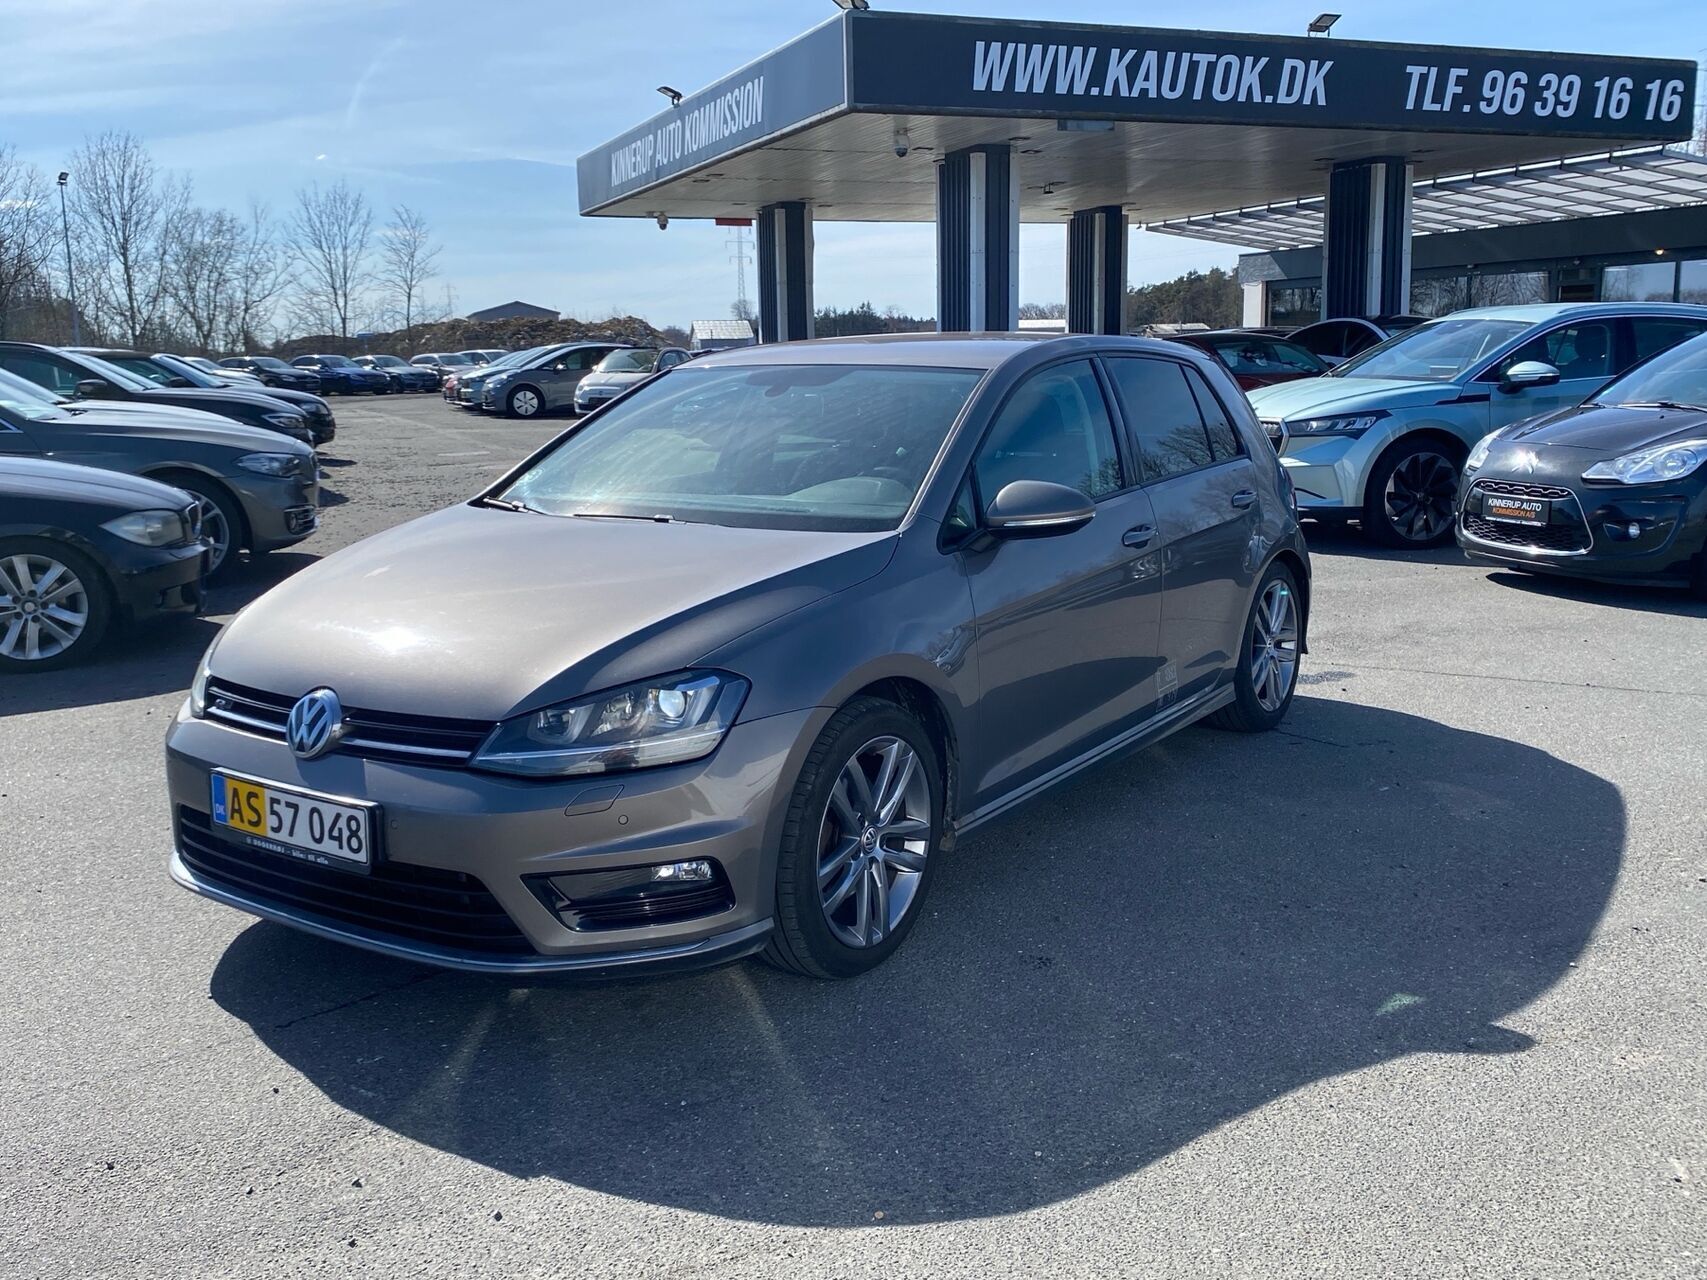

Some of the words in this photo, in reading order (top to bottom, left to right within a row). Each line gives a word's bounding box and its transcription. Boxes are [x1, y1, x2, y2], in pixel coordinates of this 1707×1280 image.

[972, 40, 1335, 106] WWW.KAUTOK.DK
[1404, 64, 1471, 113] TLF.
[1479, 69, 1528, 116] 96
[1534, 72, 1582, 118] 39
[1593, 76, 1632, 120] 16
[1644, 79, 1685, 122] 16
[611, 134, 655, 188] KINNERUP
[655, 119, 682, 169] AUTO
[684, 75, 764, 156] KOMMISSION
[1488, 498, 1521, 509] KINNERUP
[1521, 501, 1542, 512] AUTO
[215, 803, 226, 816] DK
[230, 787, 262, 828] AS
[269, 796, 300, 838] 57
[308, 806, 363, 854] 048
